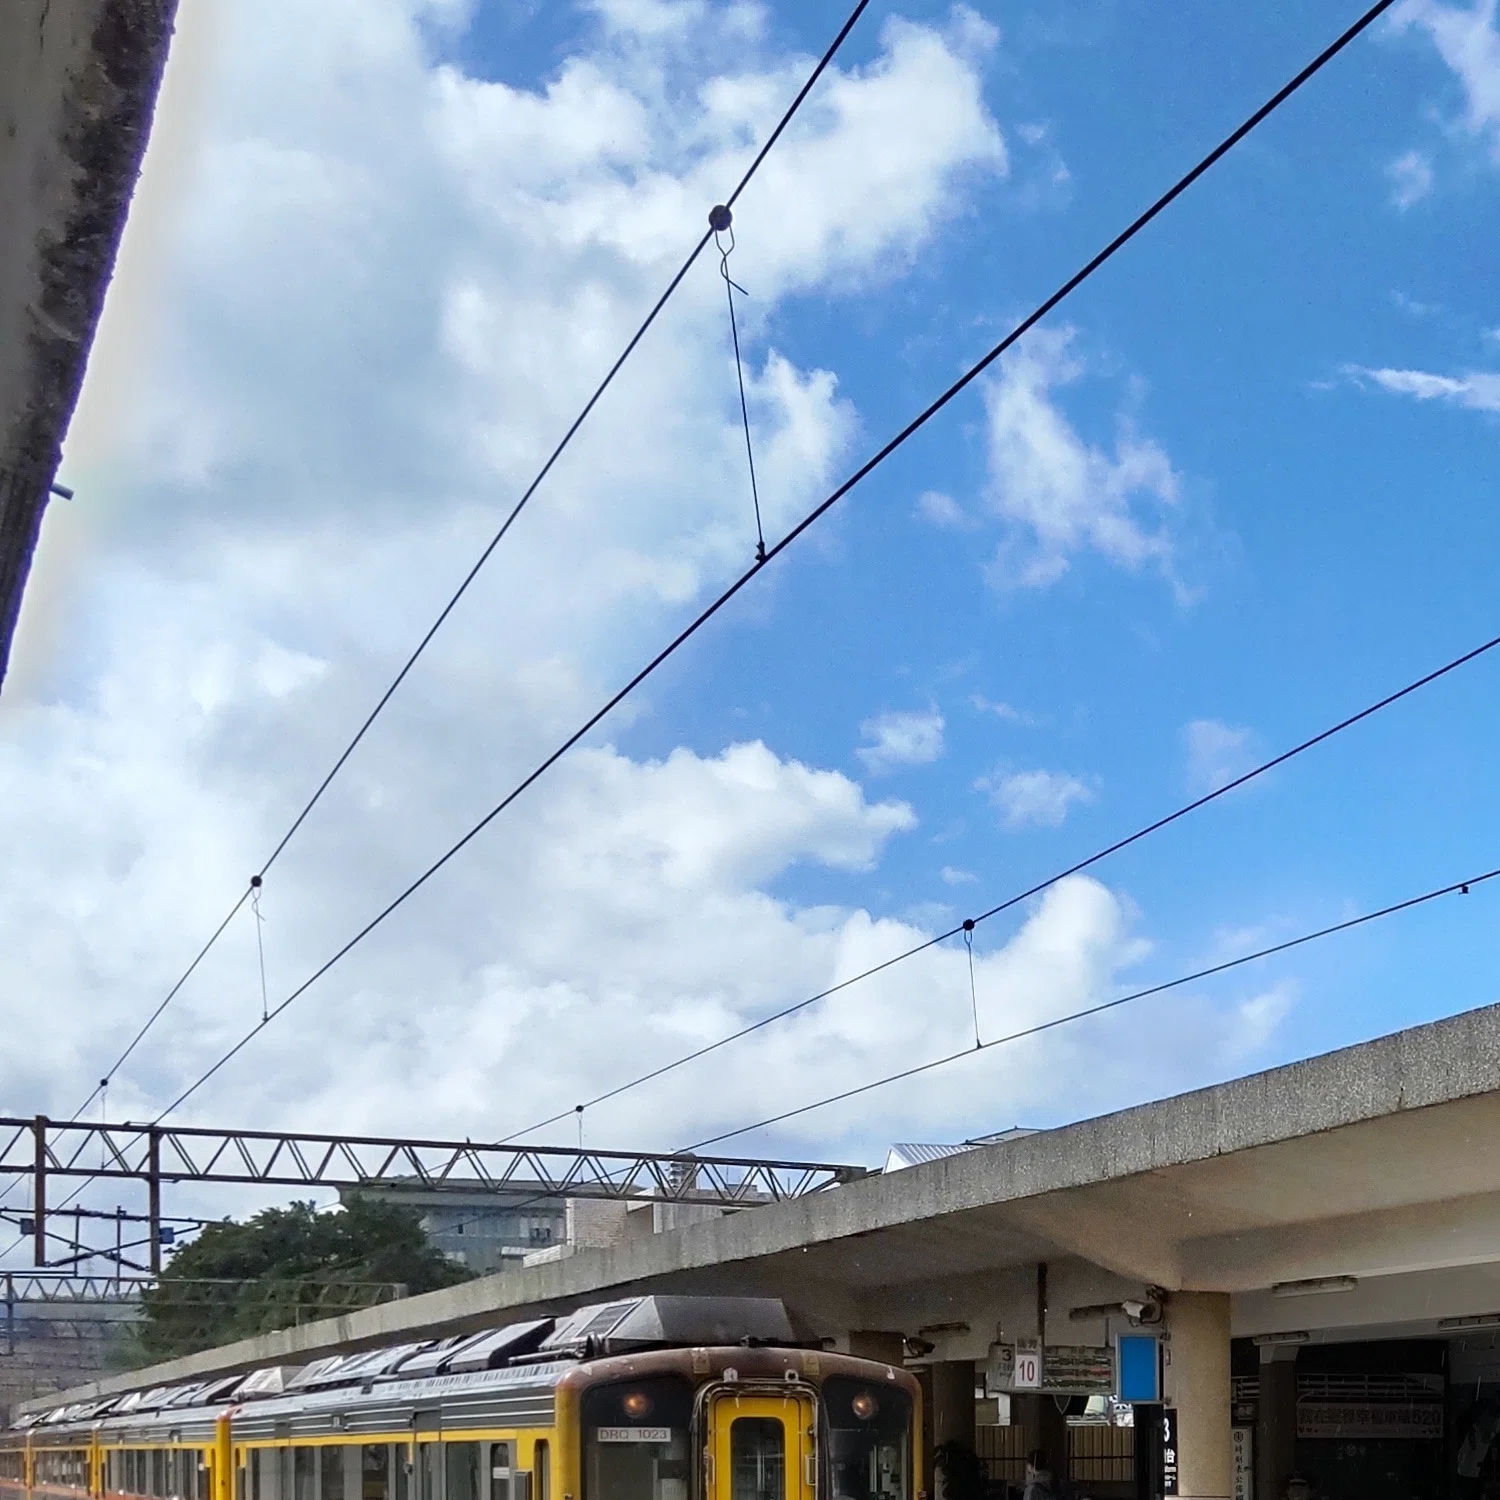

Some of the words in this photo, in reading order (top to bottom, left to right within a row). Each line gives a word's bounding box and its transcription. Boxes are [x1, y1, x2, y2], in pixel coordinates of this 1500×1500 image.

[1002, 1349, 1012, 1361] 3
[1019, 1359, 1036, 1382] 10
[637, 1429, 667, 1440] 1023
